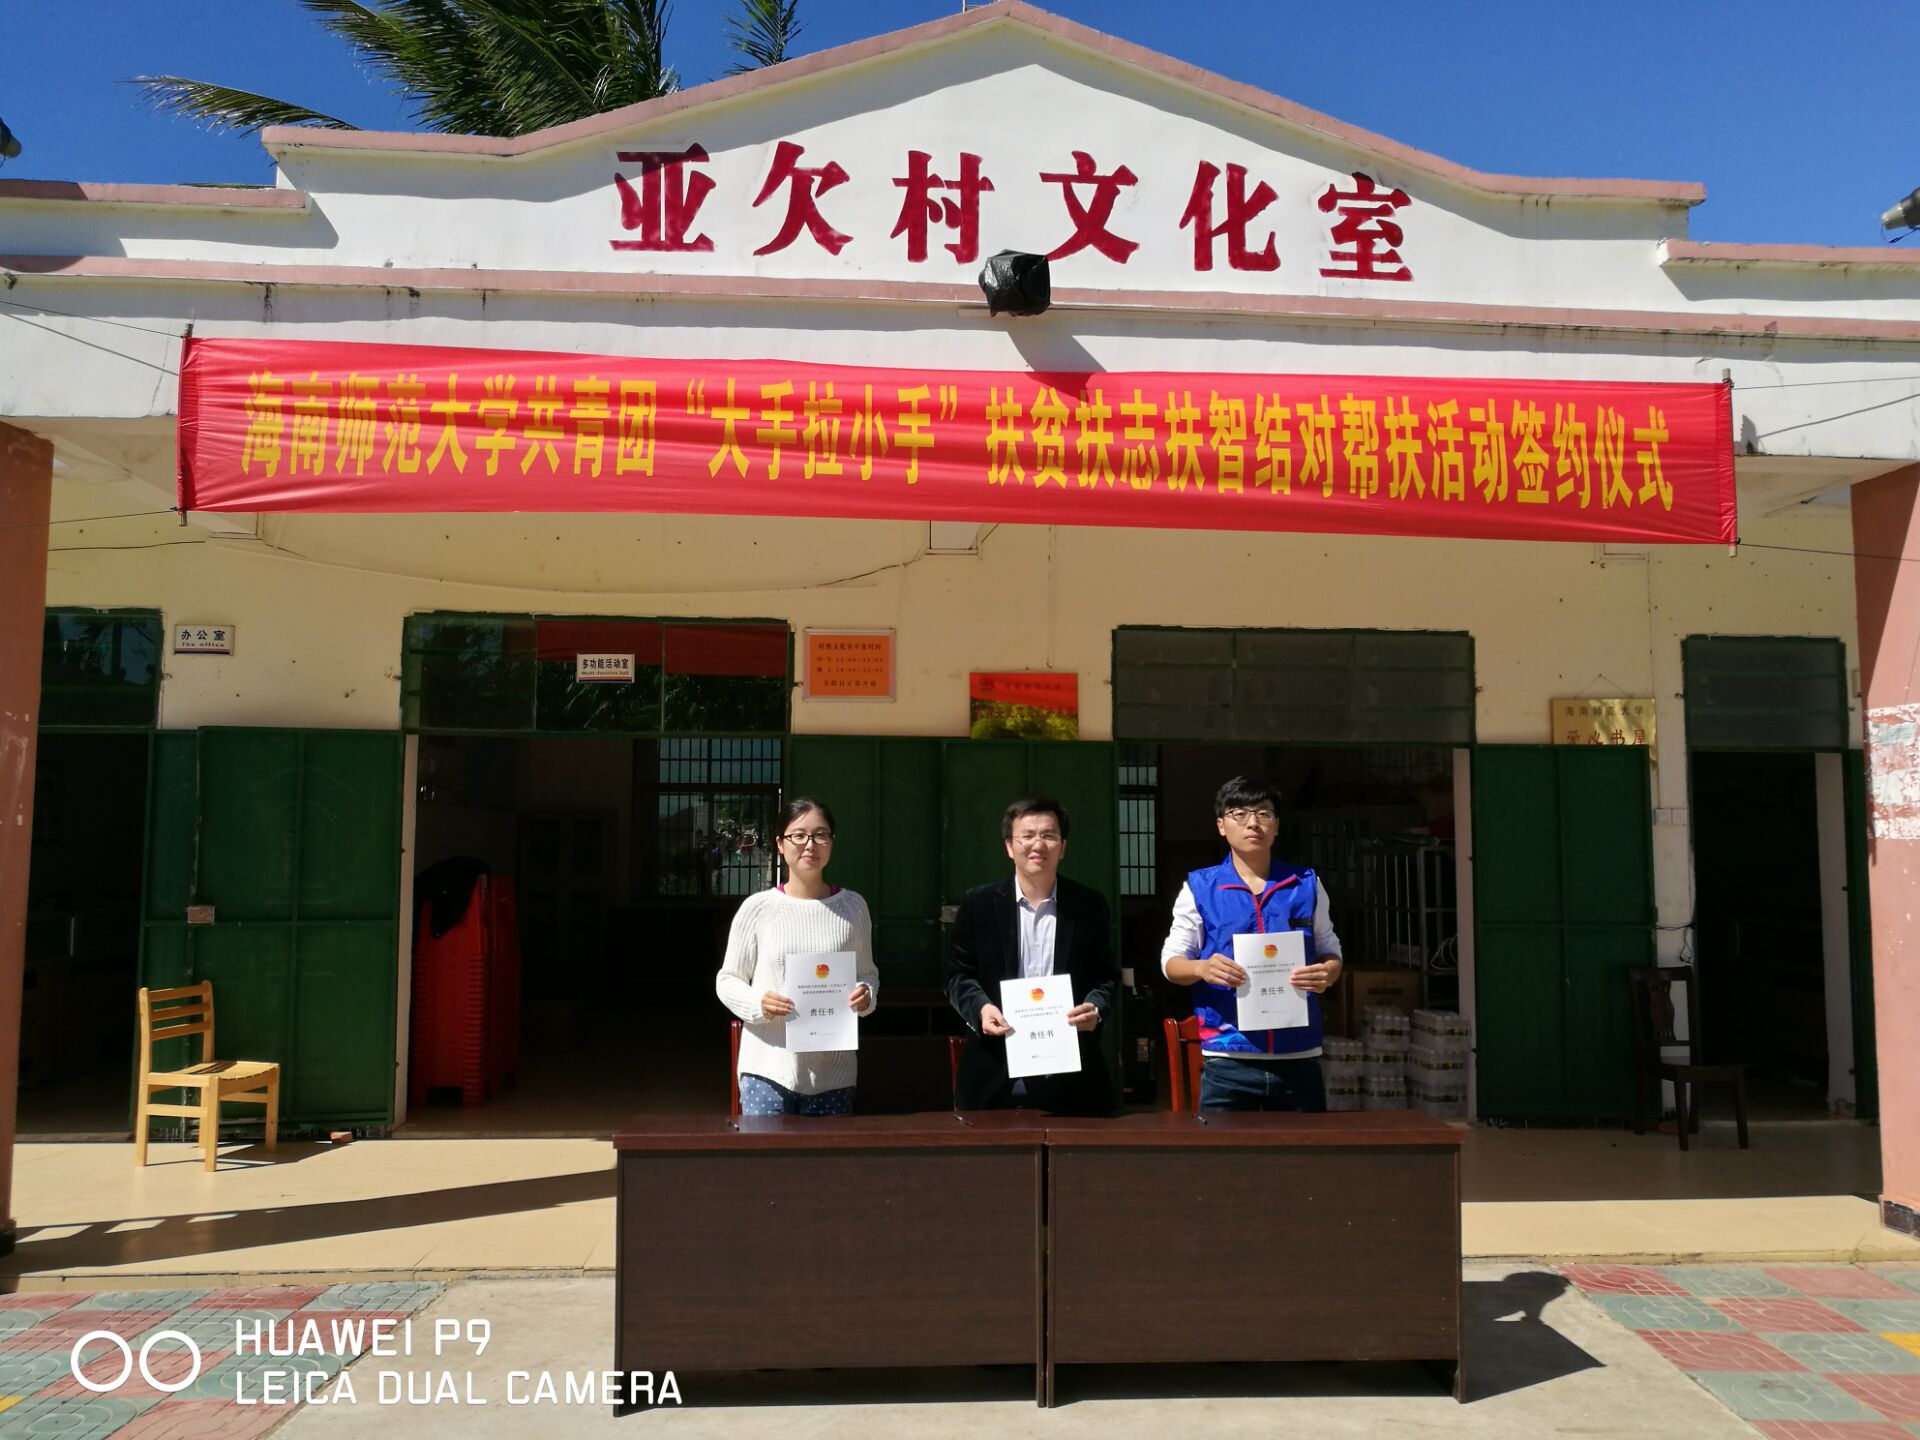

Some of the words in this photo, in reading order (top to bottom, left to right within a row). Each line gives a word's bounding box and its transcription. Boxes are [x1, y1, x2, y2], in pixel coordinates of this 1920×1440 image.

[609, 141, 1414, 283] 亚欠村文化室
[241, 371, 658, 479] 海南师范大学共青团
[686, 378, 959, 485] “大手拉小手”
[984, 385, 1674, 512] 扶贫扶志扶智结对帮扶活动签约仪式
[181, 628, 226, 641] 办公室
[582, 659, 629, 669] 多功能活动室
[1565, 705, 1644, 717] 海南师范大学
[810, 1007, 835, 1017] 责任书
[1030, 1029, 1054, 1040] 责任书
